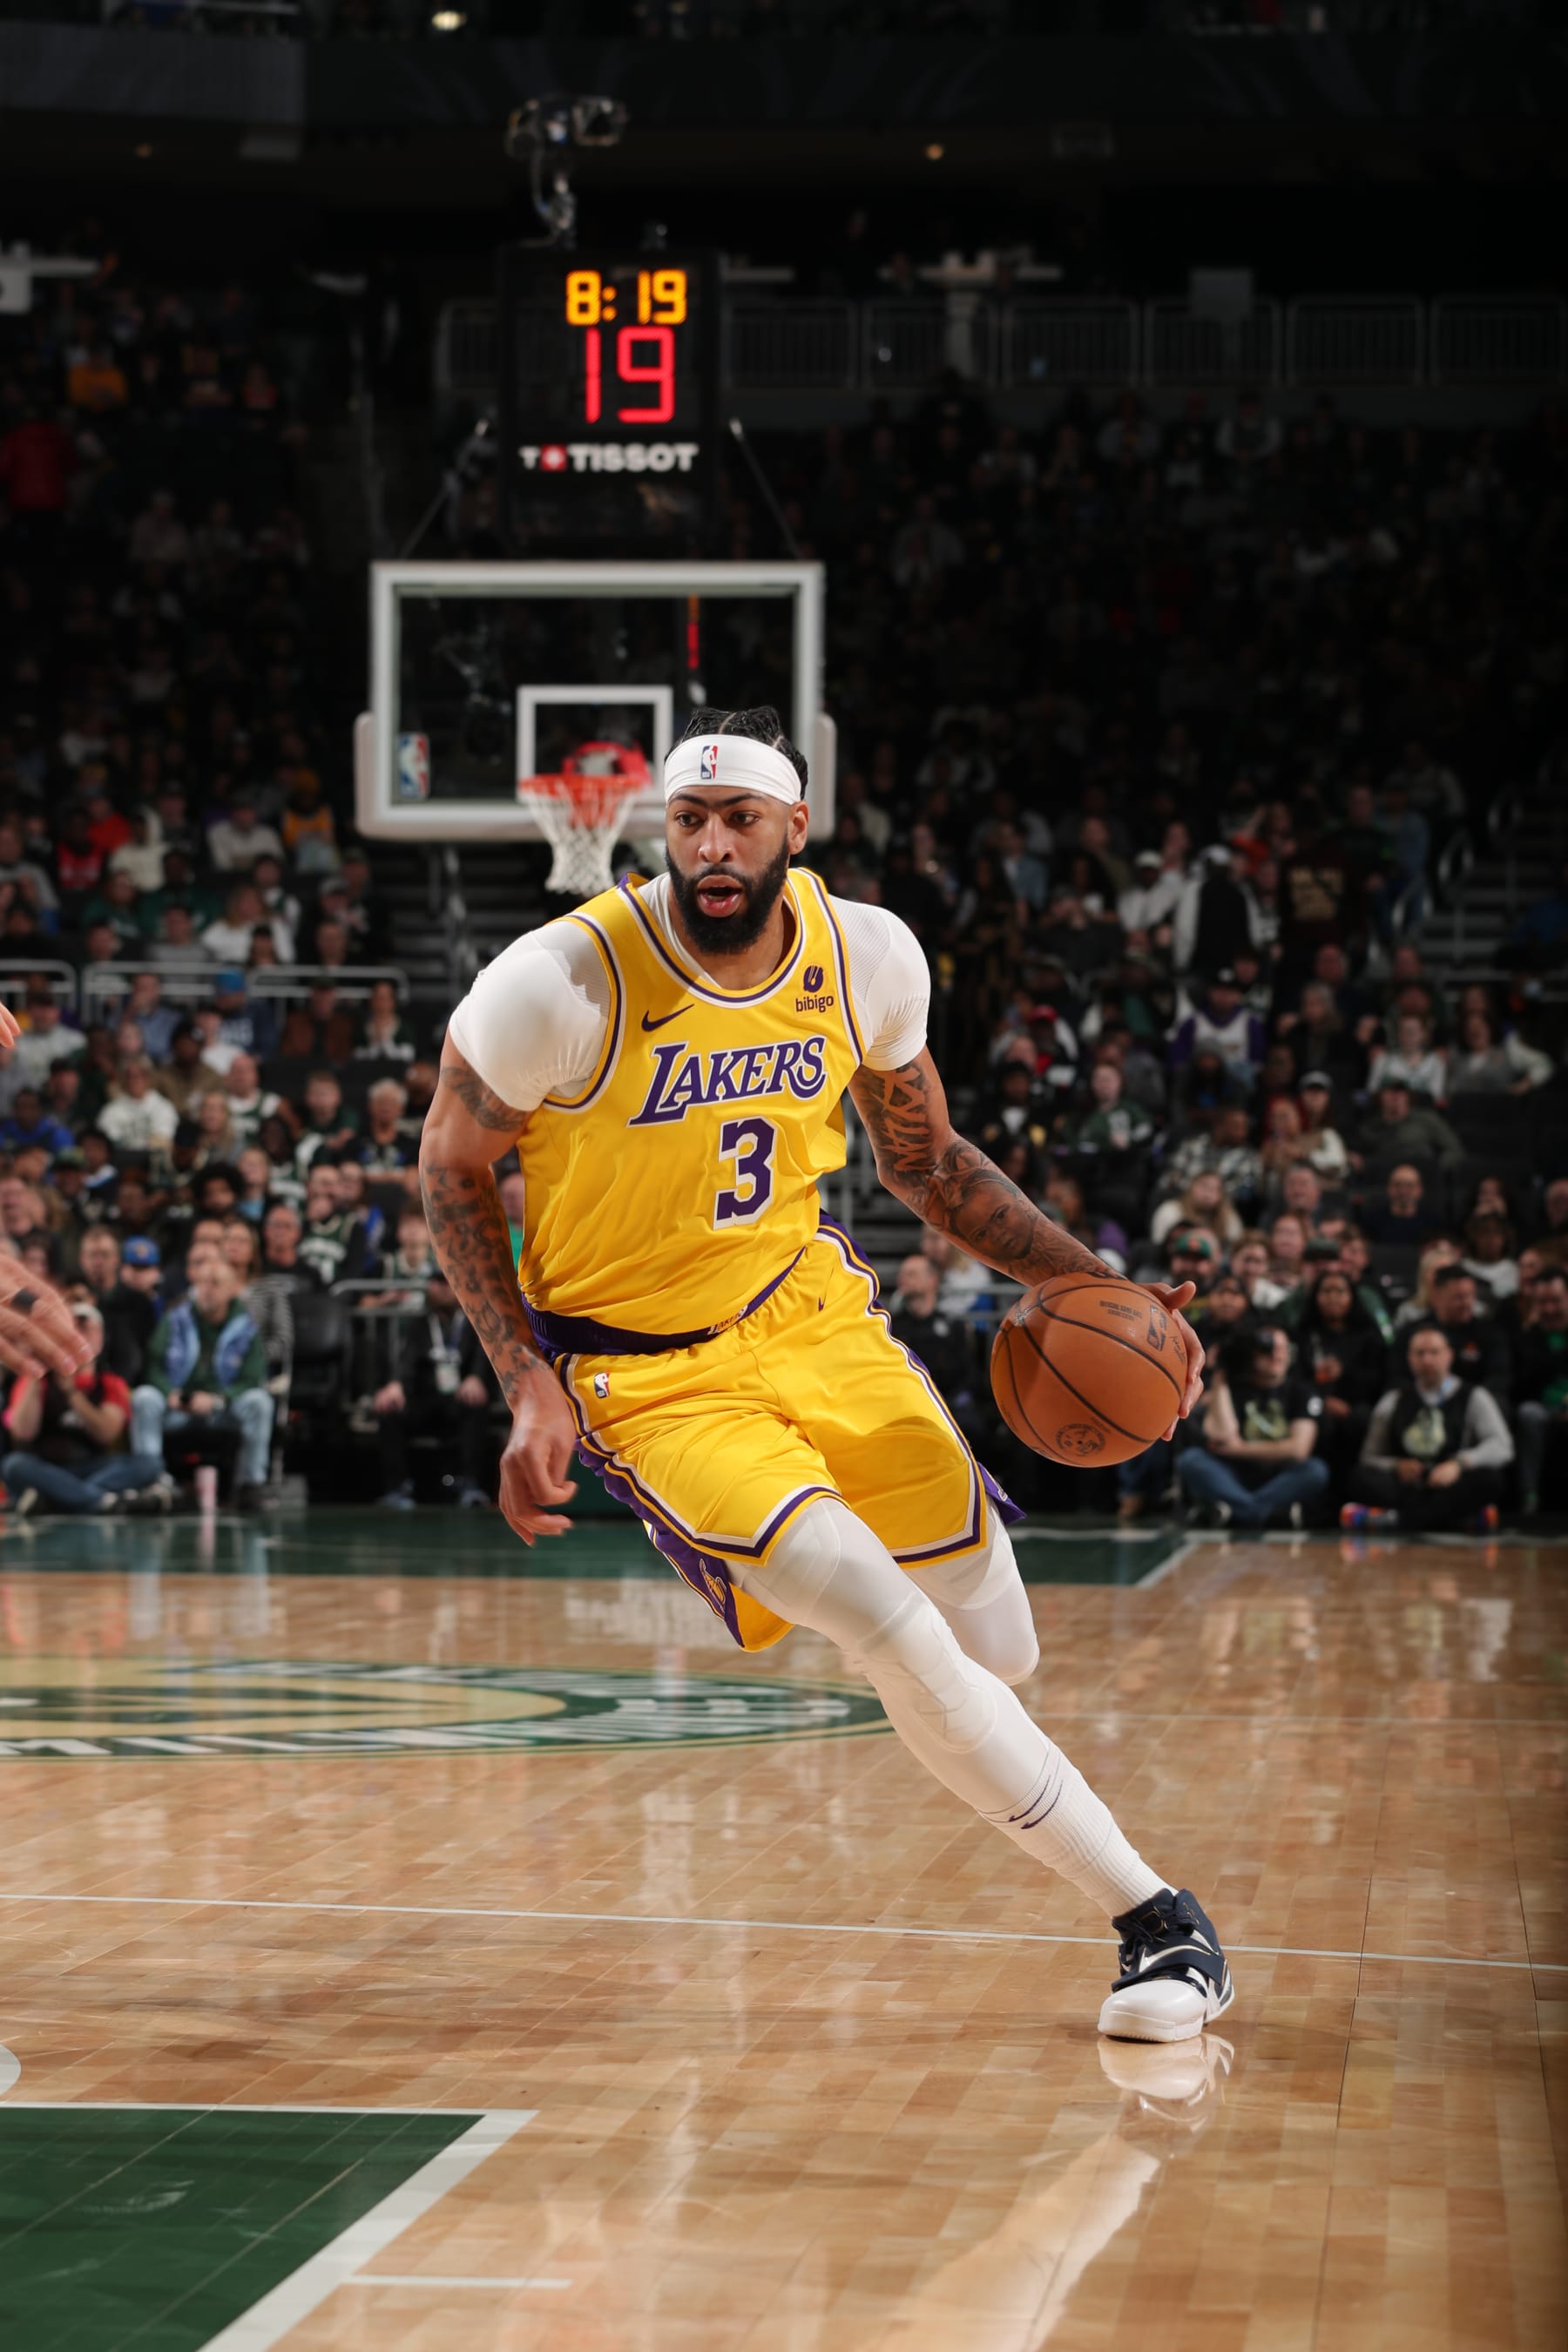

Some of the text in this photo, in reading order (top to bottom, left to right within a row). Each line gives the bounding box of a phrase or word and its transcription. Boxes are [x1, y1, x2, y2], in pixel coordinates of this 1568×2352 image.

[567, 270, 686, 325] 8:19
[586, 327, 675, 423] 19
[569, 443, 698, 471] TISSOT
[795, 995, 834, 1013] bibigo
[625, 1035, 828, 1127] LAKERS
[713, 1115, 777, 1231] 3
